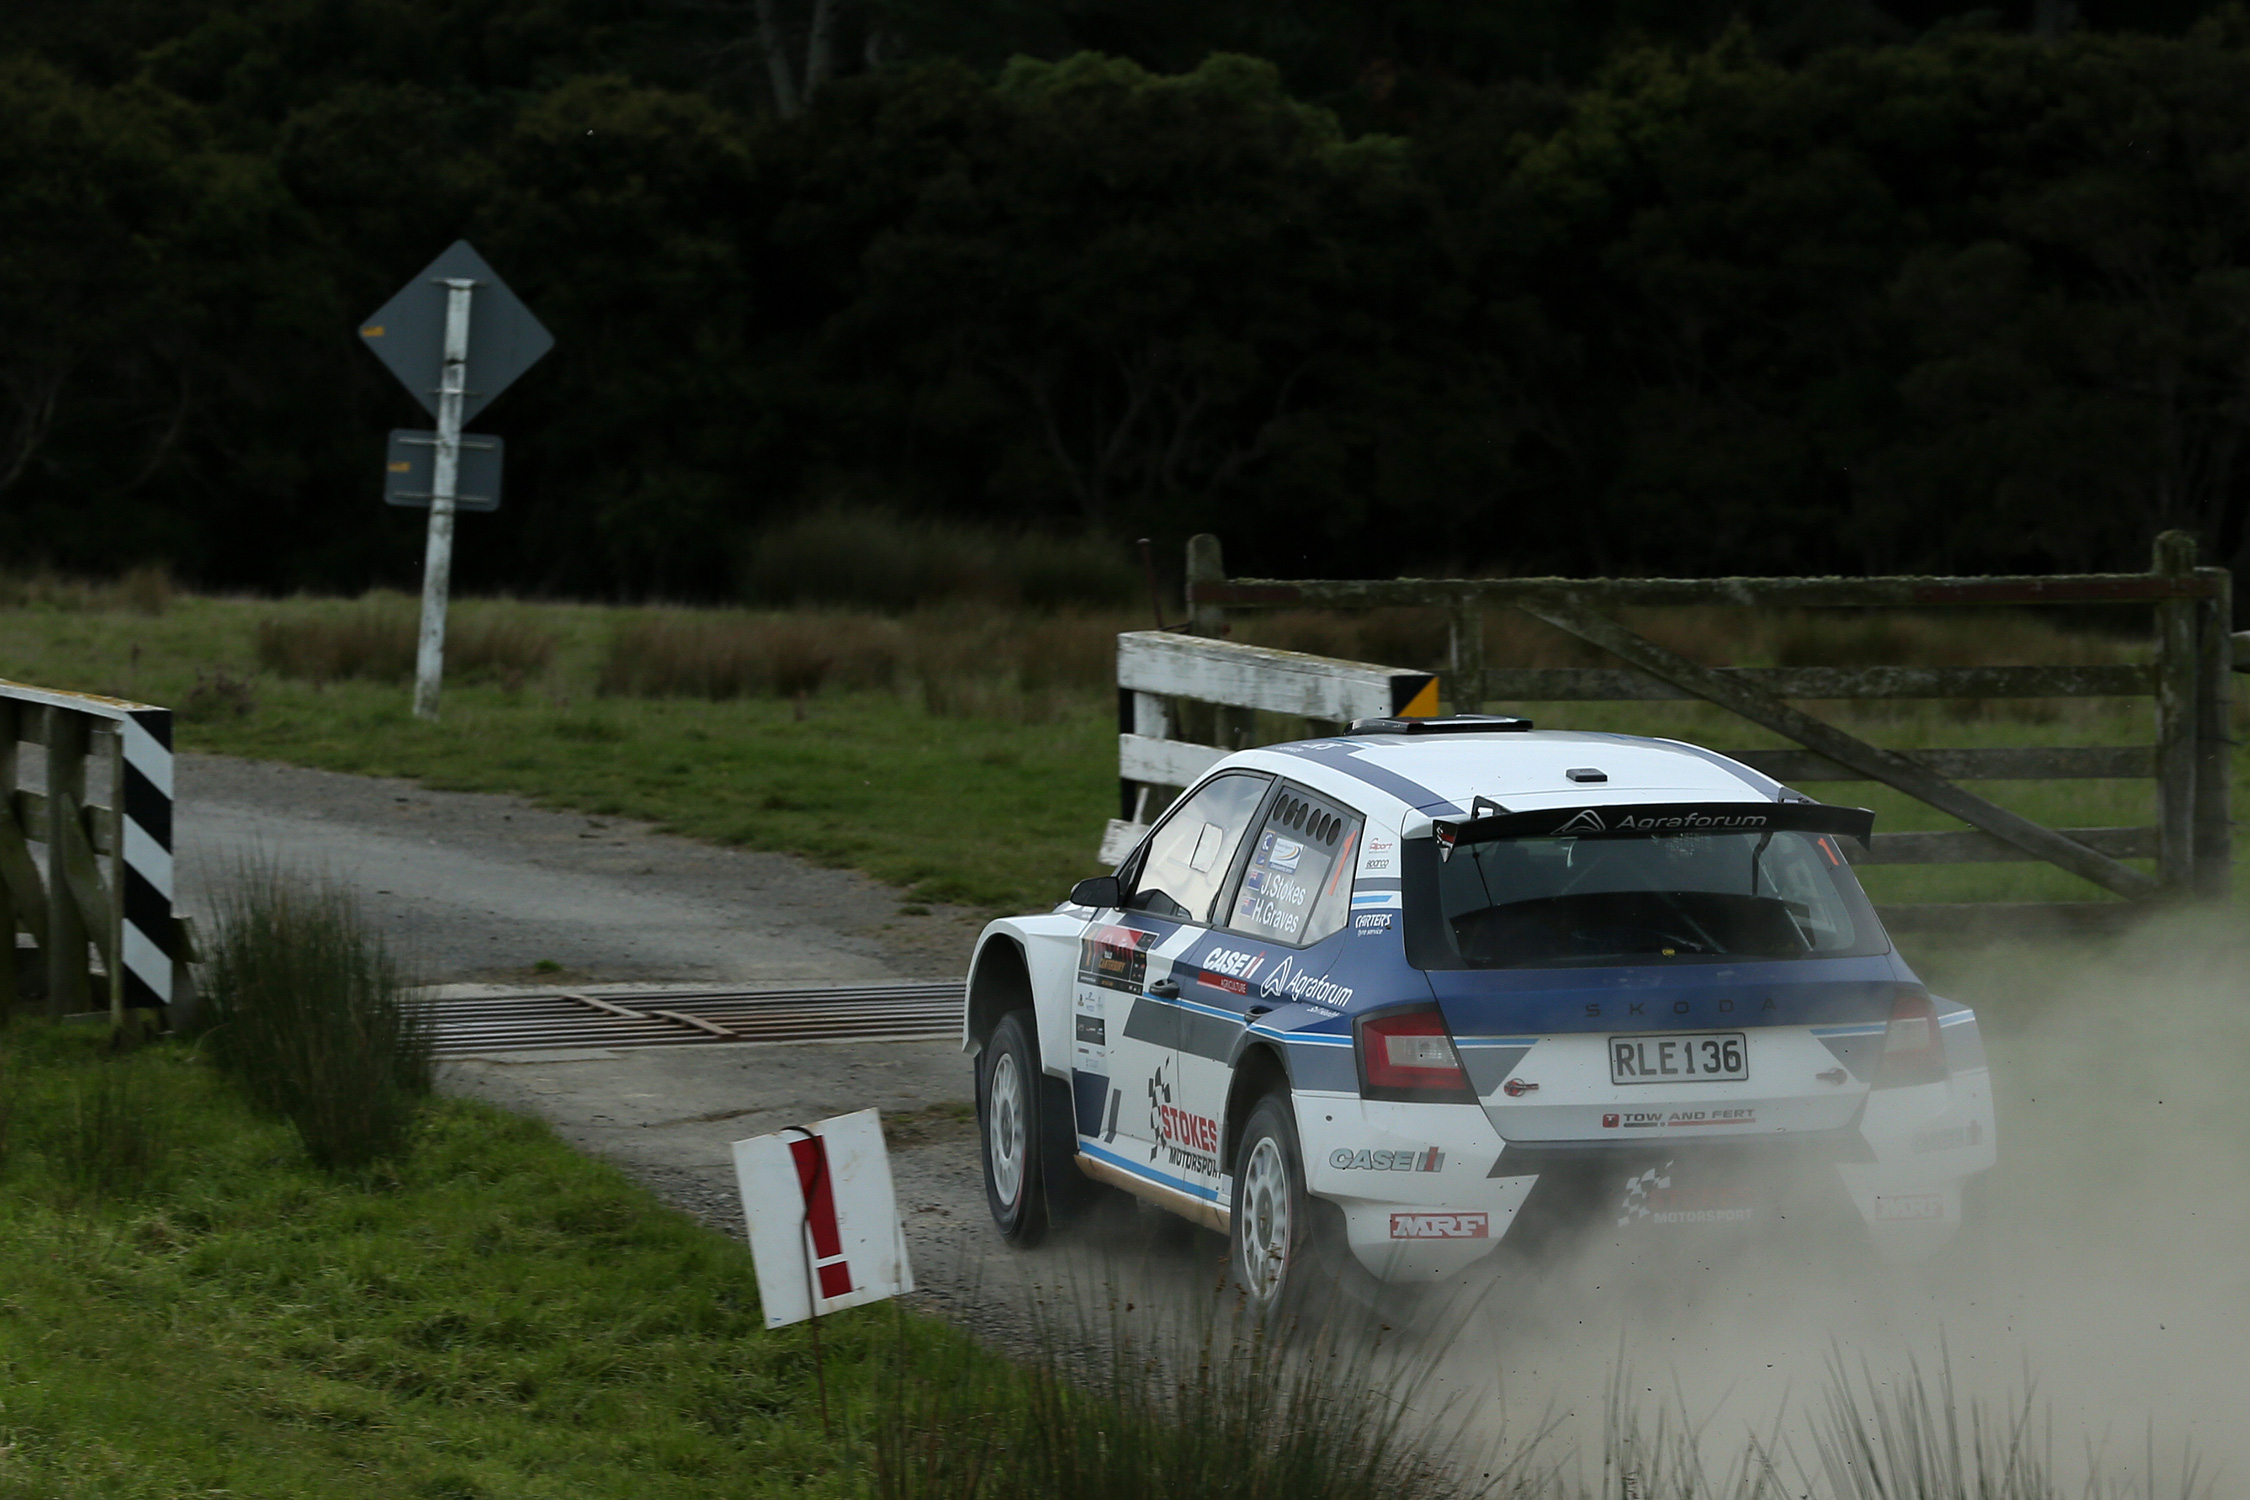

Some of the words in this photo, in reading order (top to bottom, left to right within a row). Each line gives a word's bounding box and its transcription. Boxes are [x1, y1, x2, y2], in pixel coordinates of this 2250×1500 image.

[1615, 812, 1767, 830] Agraforum
[1818, 838, 1839, 866] 1
[1260, 872, 1306, 906] J.Stokes
[1251, 898, 1299, 933] H.Graves
[1286, 968, 1353, 1007] Agraforum
[1615, 1040, 1742, 1077] RLE136
[1161, 1104, 1217, 1154] STOKES
[1623, 1113, 1663, 1122] TOW
[1669, 1111, 1706, 1121] AND
[1712, 1109, 1756, 1119] FERT
[1329, 1148, 1415, 1171] CASE
[1392, 1214, 1487, 1238] MRF
[1653, 1208, 1755, 1224] MOTORSPORT
